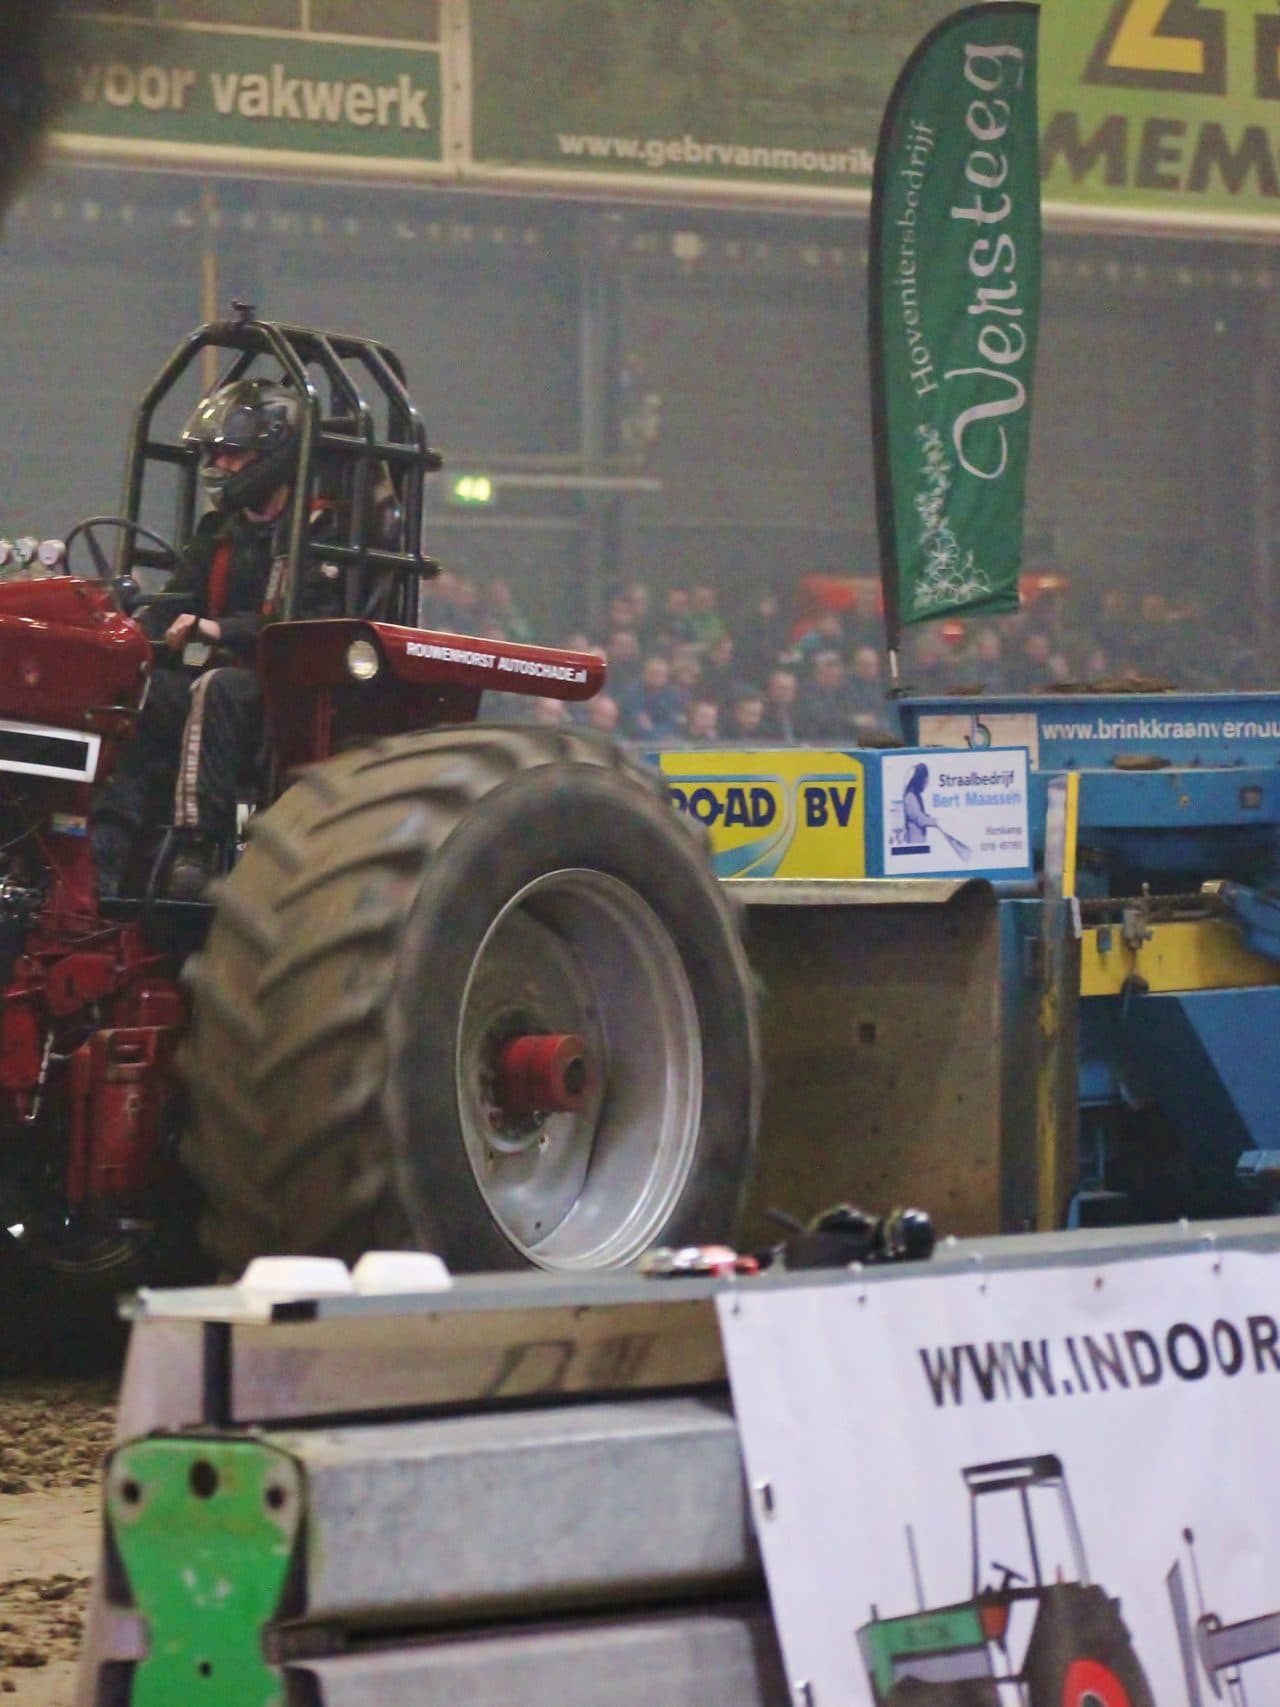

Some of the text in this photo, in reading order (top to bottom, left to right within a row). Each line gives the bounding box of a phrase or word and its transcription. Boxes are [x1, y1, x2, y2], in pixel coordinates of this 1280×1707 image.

[209, 63, 431, 129] vakwerk
[944, 42, 1027, 480] Versteeg
[804, 787, 856, 827] BV
[939, 770, 1015, 788] Straalbedrijf
[919, 1315, 1280, 1407] WWW.INDOOR
